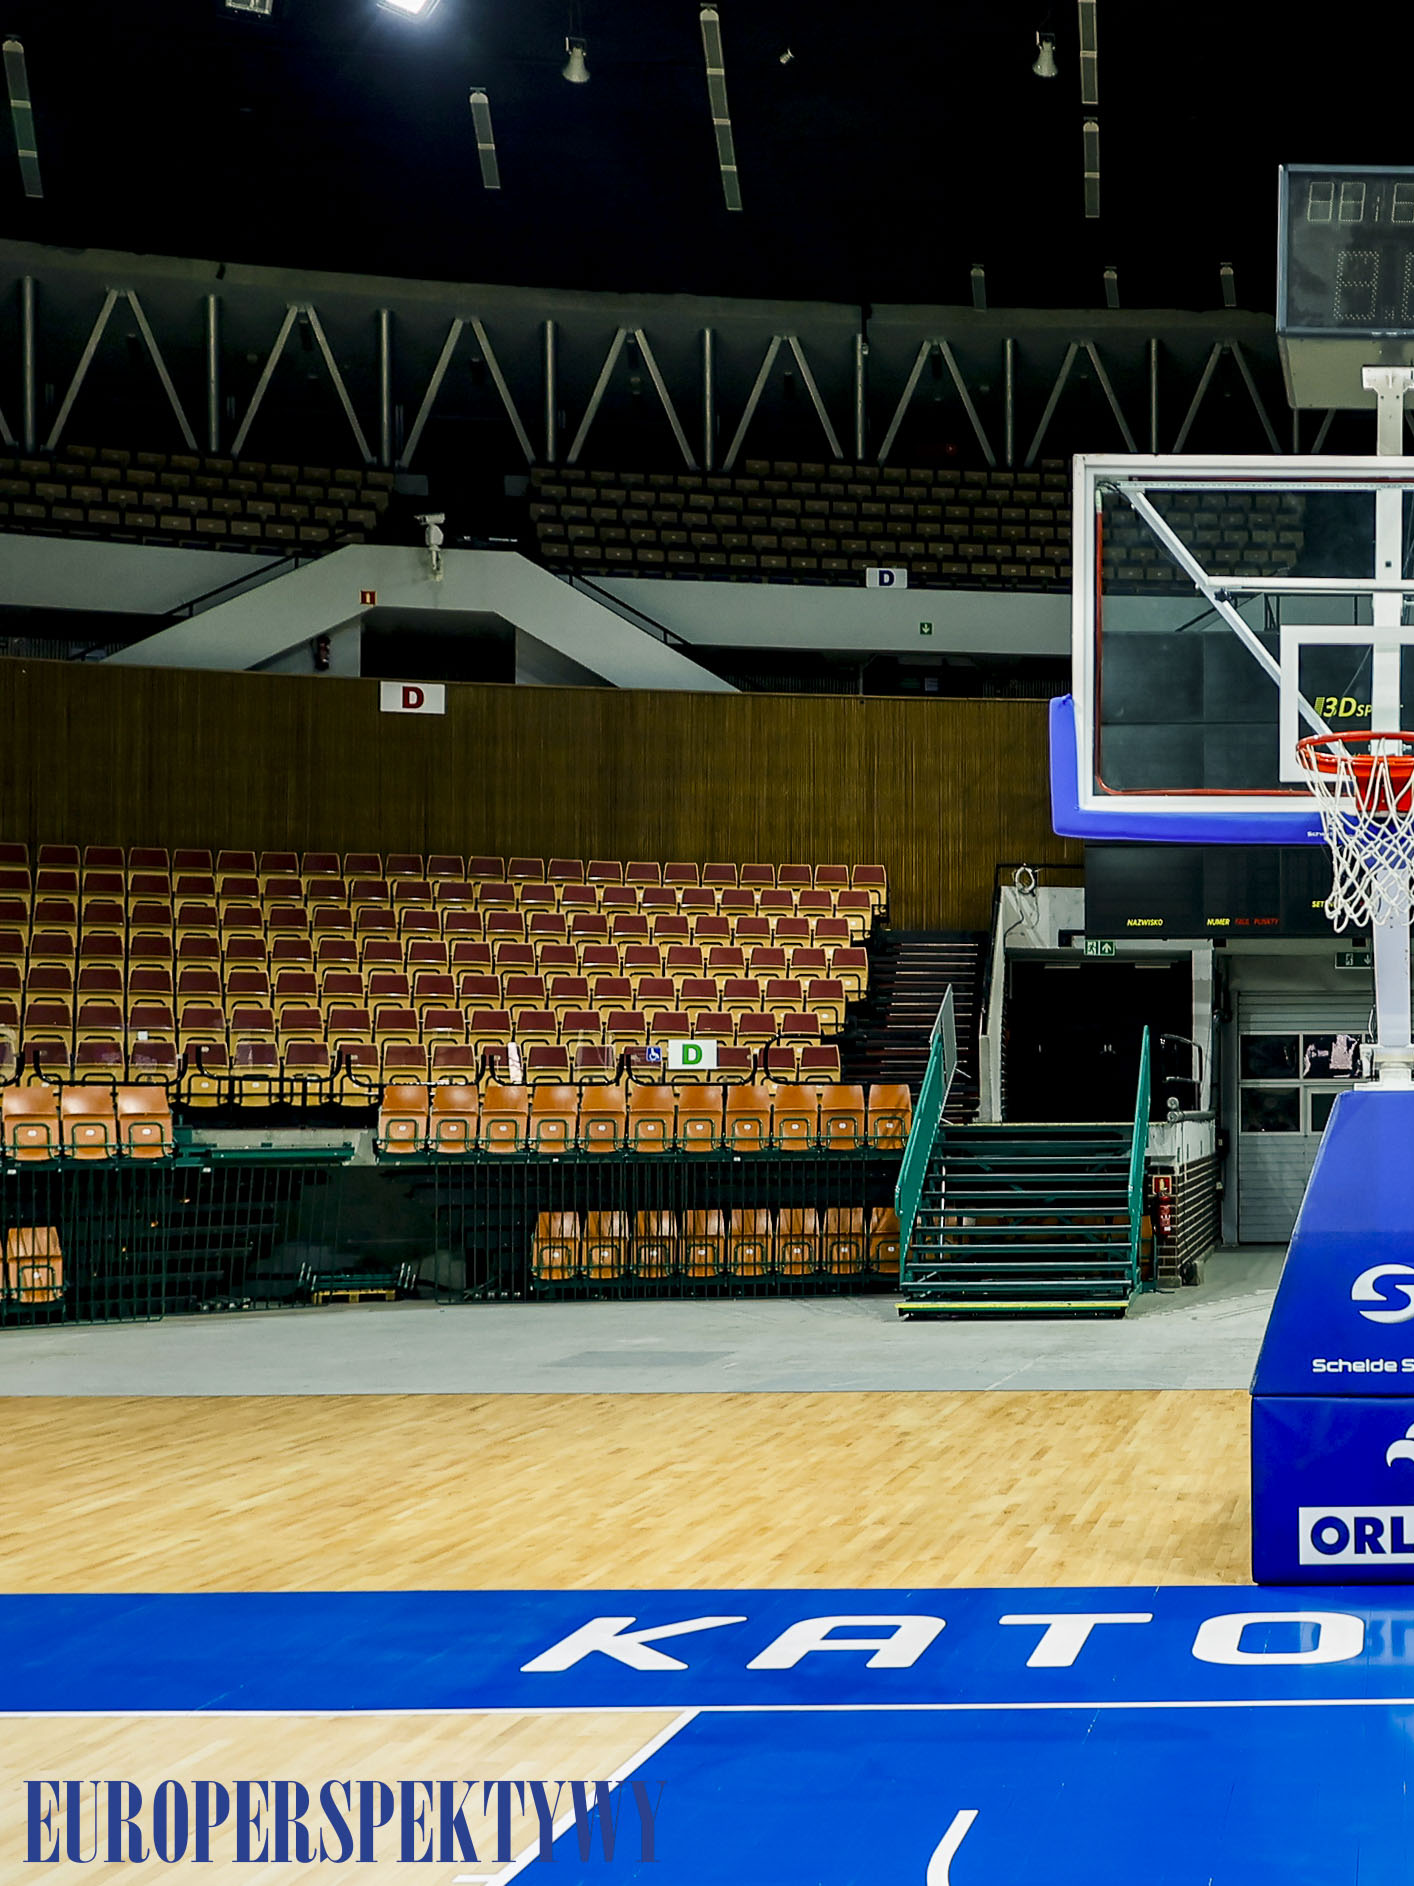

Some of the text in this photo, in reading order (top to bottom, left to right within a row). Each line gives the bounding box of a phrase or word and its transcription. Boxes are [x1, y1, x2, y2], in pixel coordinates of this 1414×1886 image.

[879, 570, 895, 586] D
[402, 686, 424, 708] D
[1127, 918, 1164, 927] NAZWISKO
[1207, 918, 1231, 927] NUMER
[1254, 918, 1280, 926] PUNKTY
[682, 1043, 702, 1065] D
[1312, 1358, 1398, 1373] Schelde
